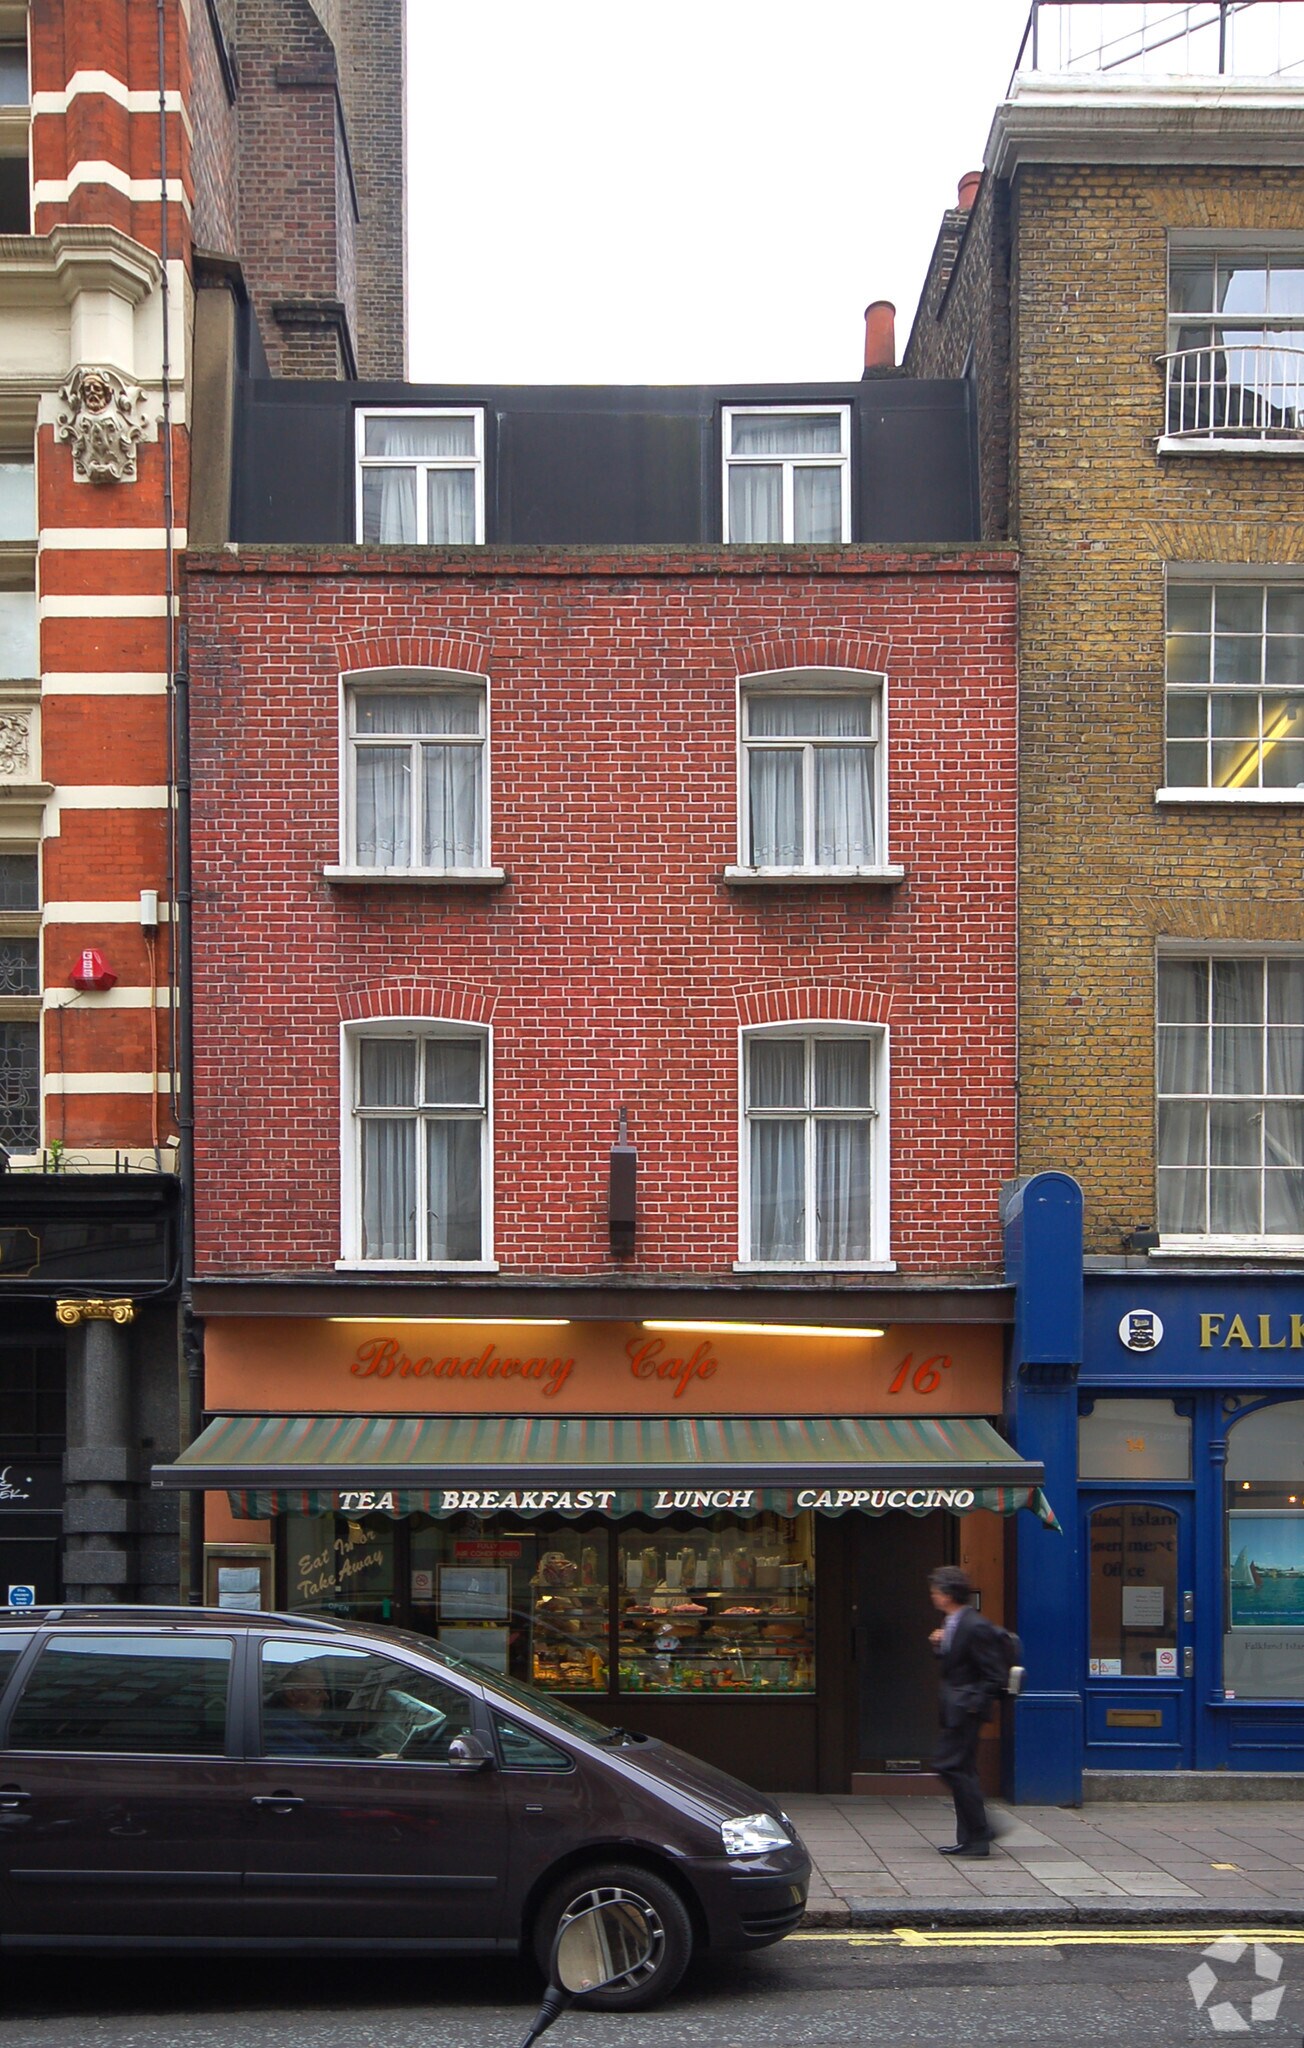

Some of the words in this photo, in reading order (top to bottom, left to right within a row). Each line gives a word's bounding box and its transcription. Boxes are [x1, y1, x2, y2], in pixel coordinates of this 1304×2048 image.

[350, 1336, 576, 1398] Broadway
[625, 1337, 720, 1399] Cafe
[887, 1352, 954, 1395] 16
[338, 1491, 395, 1511] TEA
[440, 1490, 617, 1511] BREAKFAST
[654, 1490, 754, 1509] LUNCH
[796, 1489, 976, 1509] CAPPUCCINO
[476, 1542, 499, 1550] FULLY
[296, 1572, 337, 1599] Take
[338, 1550, 384, 1583] Away
[297, 1549, 330, 1576] Eat
[328, 1602, 351, 1613] OPEN
